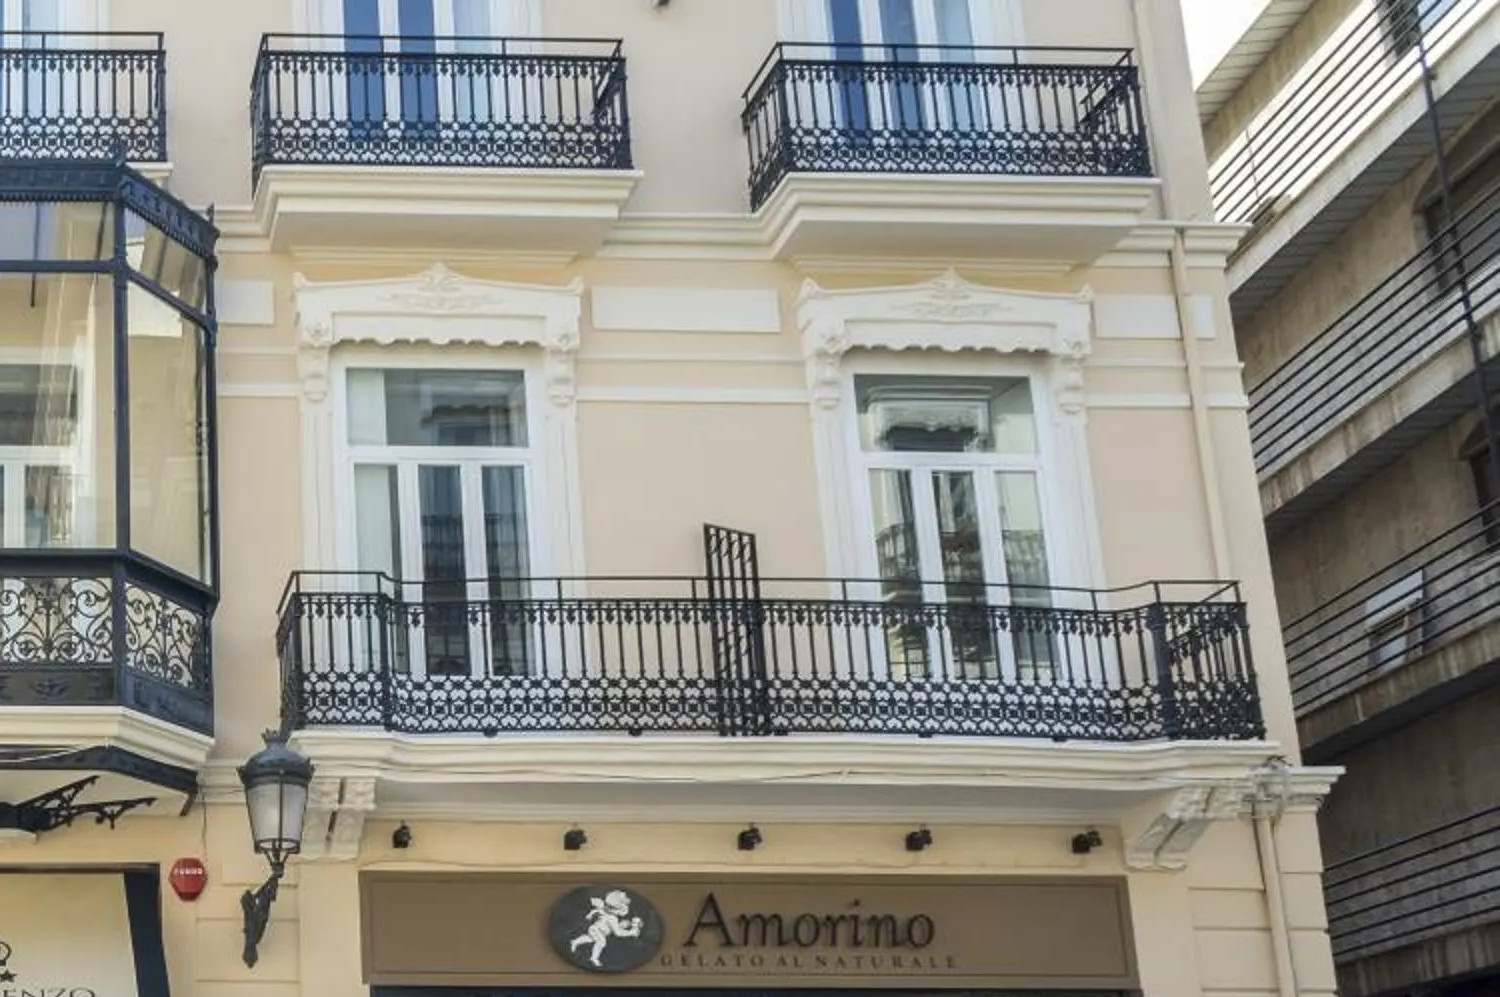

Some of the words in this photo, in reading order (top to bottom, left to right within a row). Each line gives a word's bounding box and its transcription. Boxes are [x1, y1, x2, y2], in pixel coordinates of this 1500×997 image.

[683, 891, 936, 948] Amorino
[660, 953, 765, 967] GELATO
[775, 953, 803, 967] AL
[815, 954, 957, 969] NATURALE
